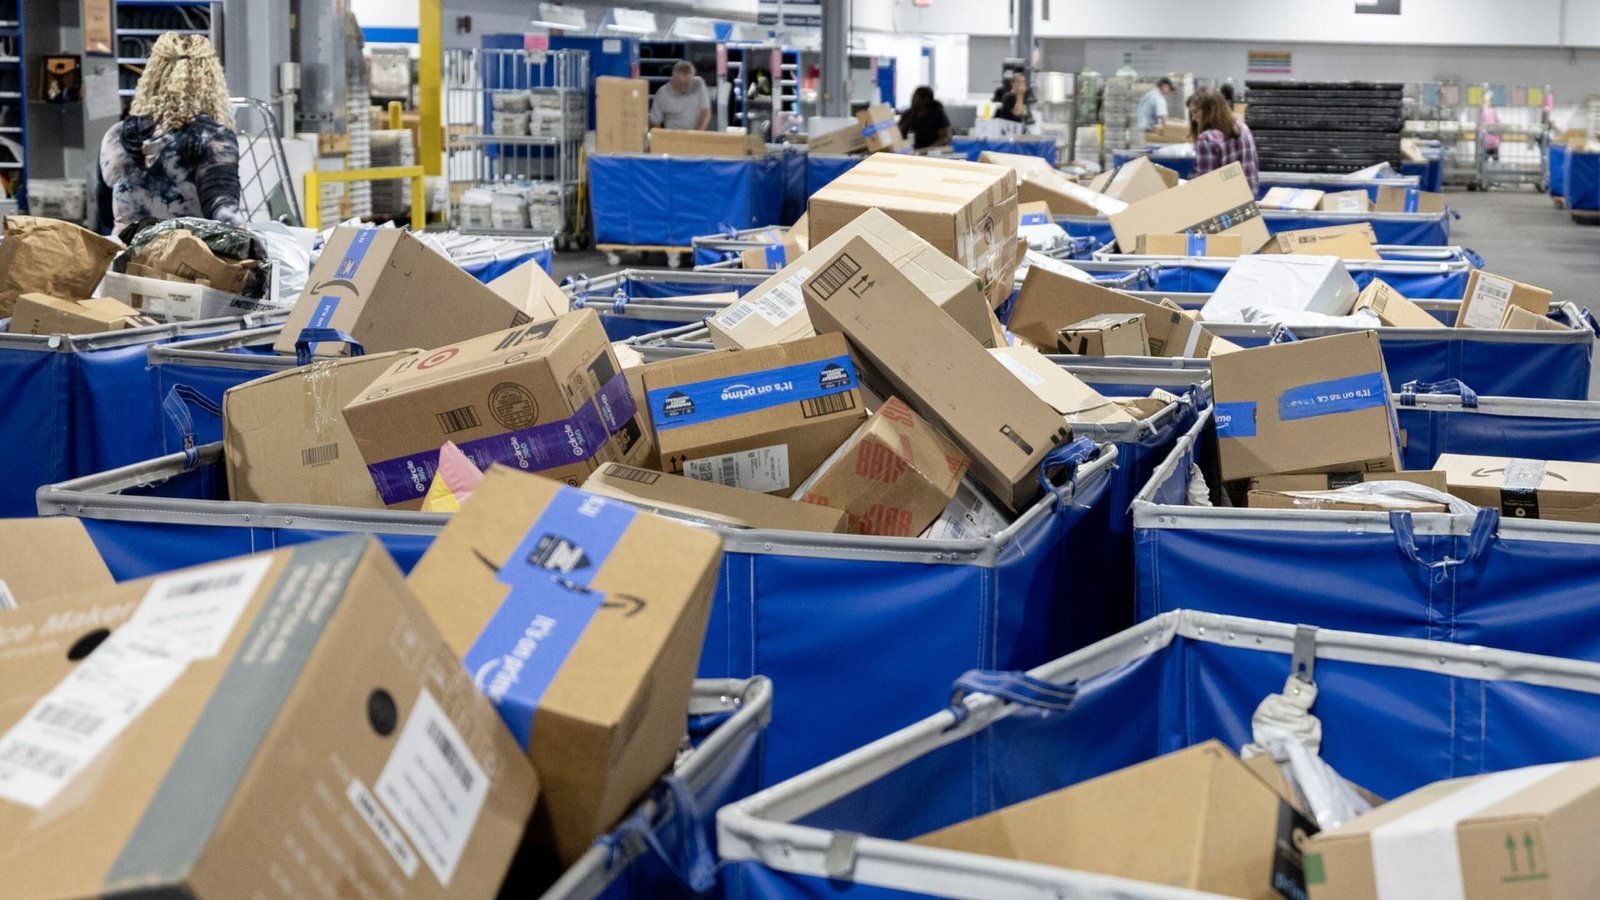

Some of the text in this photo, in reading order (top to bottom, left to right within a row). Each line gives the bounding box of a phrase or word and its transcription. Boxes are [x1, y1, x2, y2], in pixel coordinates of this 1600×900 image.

[230, 298, 254, 310] UNITED
[721, 381, 793, 402] It's on prime
[1342, 388, 1371, 400] It's on
[1215, 413, 1232, 423] ime
[565, 424, 579, 450] circle
[510, 436, 525, 463] circle
[520, 443, 531, 459] 360
[407, 460, 421, 486] circle
[416, 466, 427, 482] 360
[525, 614, 557, 641] It's
[512, 637, 538, 661] on
